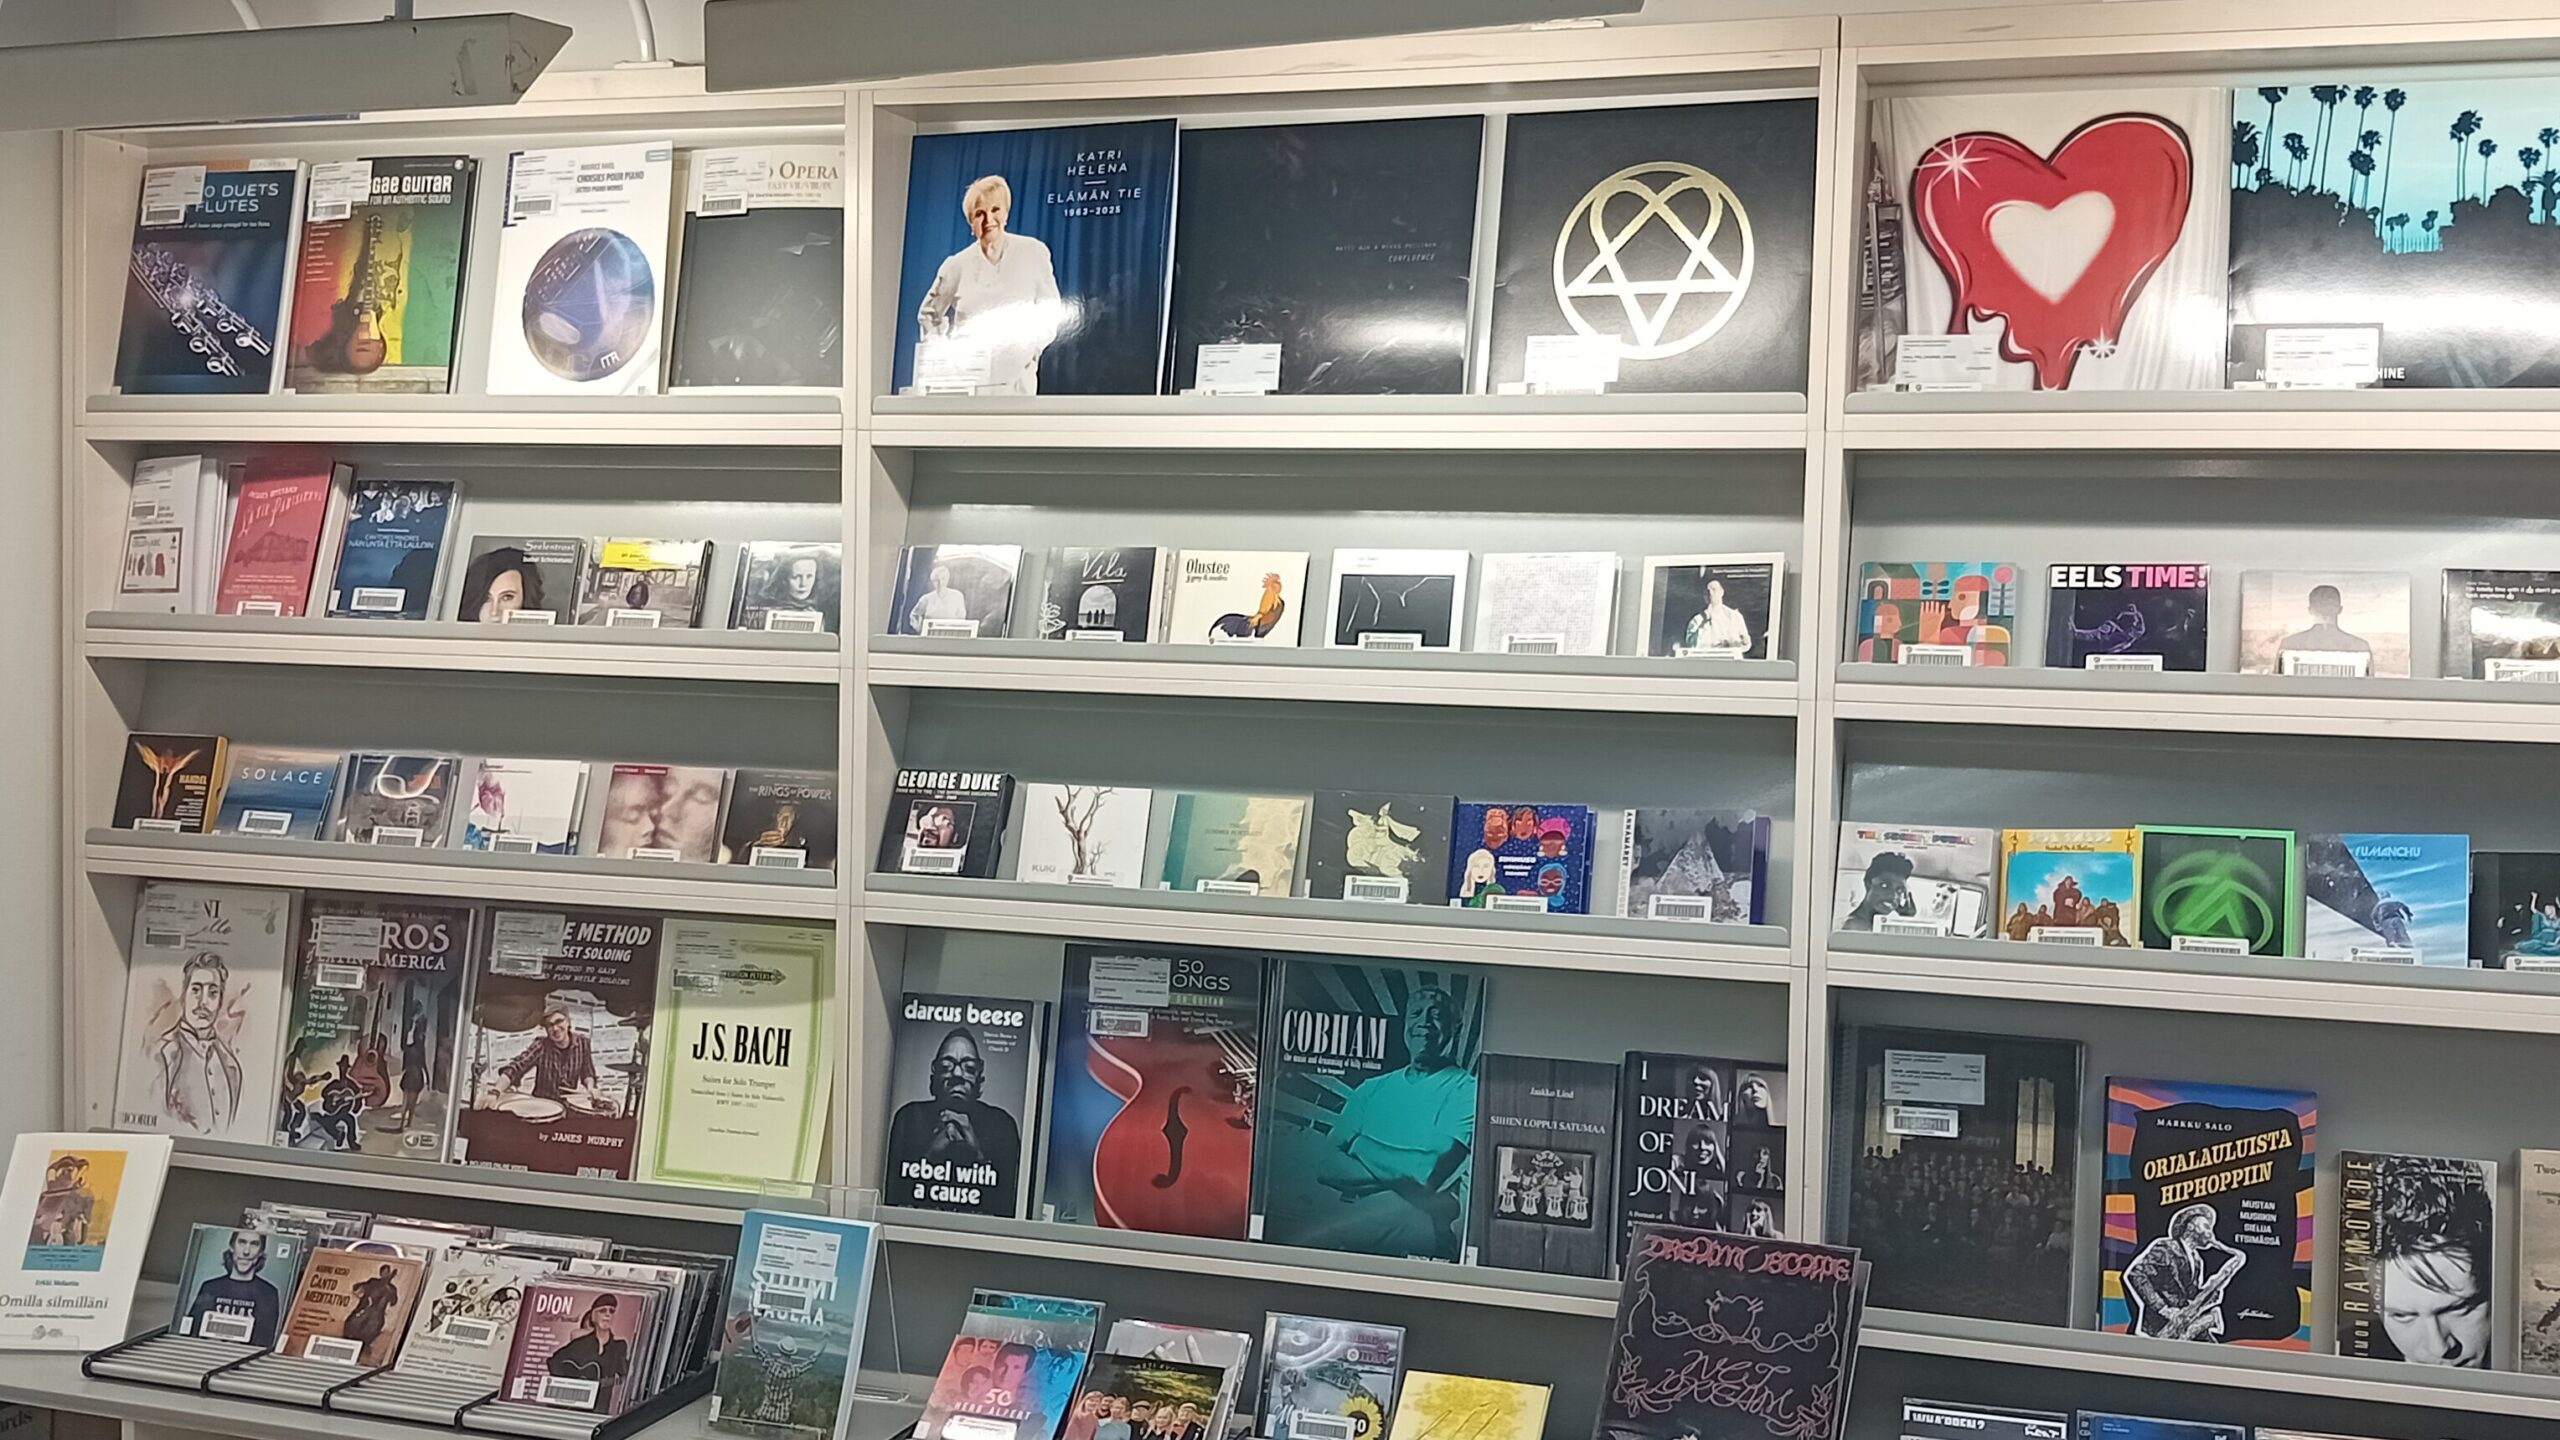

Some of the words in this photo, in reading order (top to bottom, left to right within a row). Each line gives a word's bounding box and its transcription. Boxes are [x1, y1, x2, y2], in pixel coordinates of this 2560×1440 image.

[1076, 150, 1122, 163] KATRI
[779, 161, 839, 180] OPERA
[1067, 163, 1128, 177] HELENA
[221, 183, 279, 198] DUETS
[1047, 187, 1110, 204] ELÄMÄN
[1117, 187, 1142, 198] TIE
[195, 199, 260, 214] FLUTES
[1081, 551, 1128, 579] Vila
[1186, 558, 1230, 575] Olustee
[2049, 565, 2123, 588] EELS
[2125, 565, 2207, 589] TIME!
[241, 767, 324, 784] SOLACE
[897, 770, 958, 790] GEORGE
[959, 772, 1001, 792] DUKE
[758, 785, 791, 798] RINGS
[796, 787, 832, 801] POWER
[578, 922, 652, 946] METHOD
[374, 954, 447, 971] AMERICA
[584, 946, 633, 963] SOLOING
[1177, 959, 1205, 974] 50
[1171, 973, 1231, 991] ONGS
[903, 999, 963, 1023] darcus
[966, 1003, 1025, 1027] beese
[1282, 1008, 1388, 1060] COBHAM
[732, 1024, 793, 1068] BACH
[1640, 1060, 1649, 1081] I
[1639, 1095, 1729, 1123] DREAM
[1523, 1118, 1558, 1130] LOPPUI
[1558, 1121, 1607, 1135] SATUMAA
[2156, 1117, 2202, 1130] MARKKU
[2204, 1121, 2233, 1132] SALO
[551, 1132, 583, 1145] JAMES
[587, 1135, 625, 1148] MURPHY
[1639, 1130, 1675, 1154] OF
[2143, 1128, 2294, 1182] ORJALAULUISTA
[901, 1158, 952, 1182] rebel
[955, 1163, 998, 1186] with
[1627, 1165, 1697, 1196] JONI
[2159, 1160, 2275, 1206] HIPHOPPIIN
[913, 1184, 926, 1199] a
[929, 1184, 982, 1205] cause
[2241, 1199, 2276, 1211] MUSTAN
[2243, 1223, 2273, 1234] SIELUA
[2342, 1160, 2373, 1314] RAYMONDE
[310, 1274, 338, 1292] CANTO
[0, 1294, 43, 1309] Omilla
[45, 1295, 109, 1310] silmilläni
[304, 1290, 351, 1308] MEDITATIVO
[536, 1294, 575, 1315] DION
[983, 1388, 1013, 1407] 50
[954, 1400, 986, 1415] HERB
[987, 1406, 1033, 1423] ALPERT
